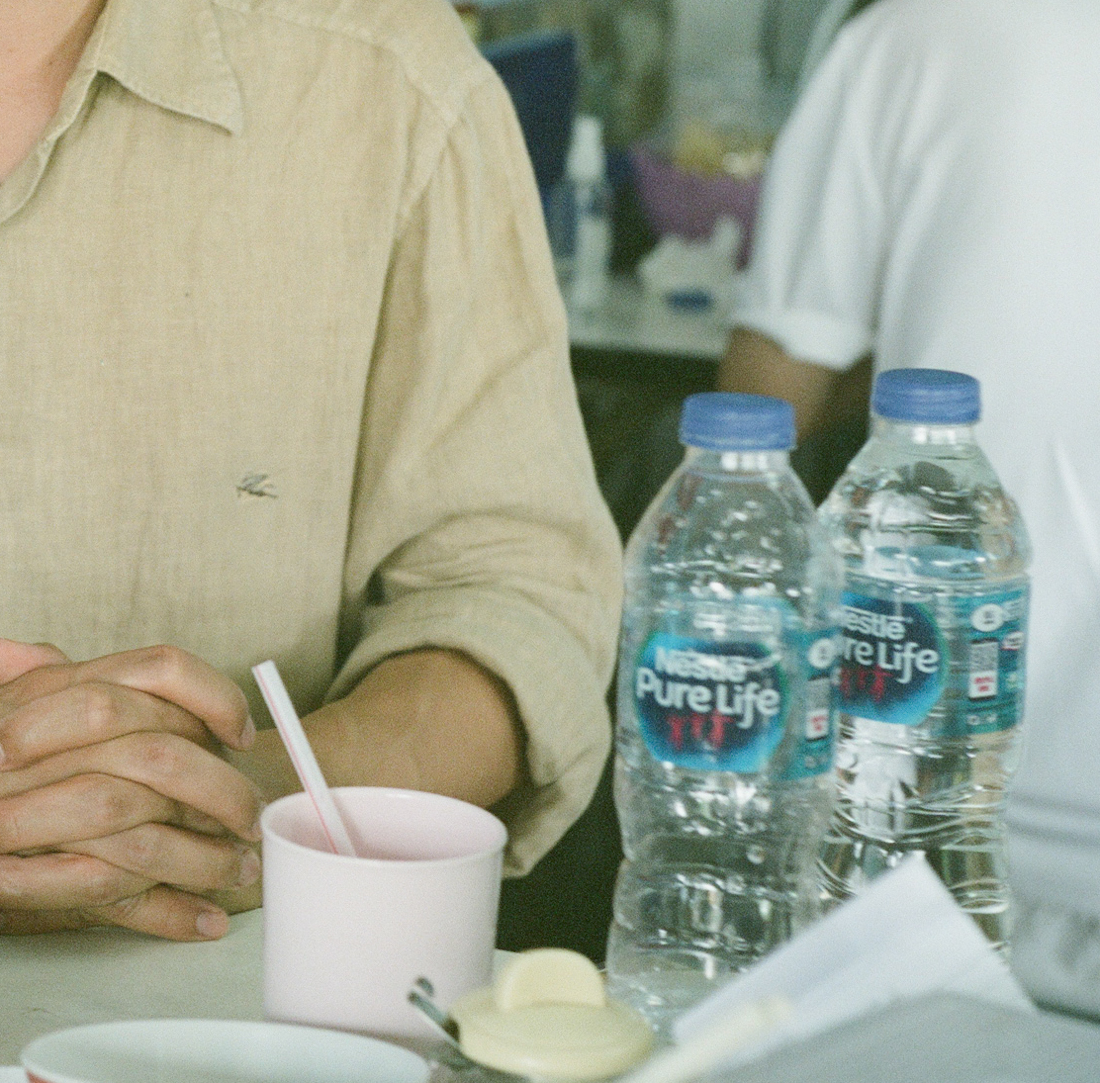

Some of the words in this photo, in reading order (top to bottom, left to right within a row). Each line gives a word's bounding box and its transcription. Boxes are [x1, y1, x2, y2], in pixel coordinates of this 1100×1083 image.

[877, 641, 941, 685] Life
[637, 666, 712, 714] Pure
[716, 681, 780, 730] Life
